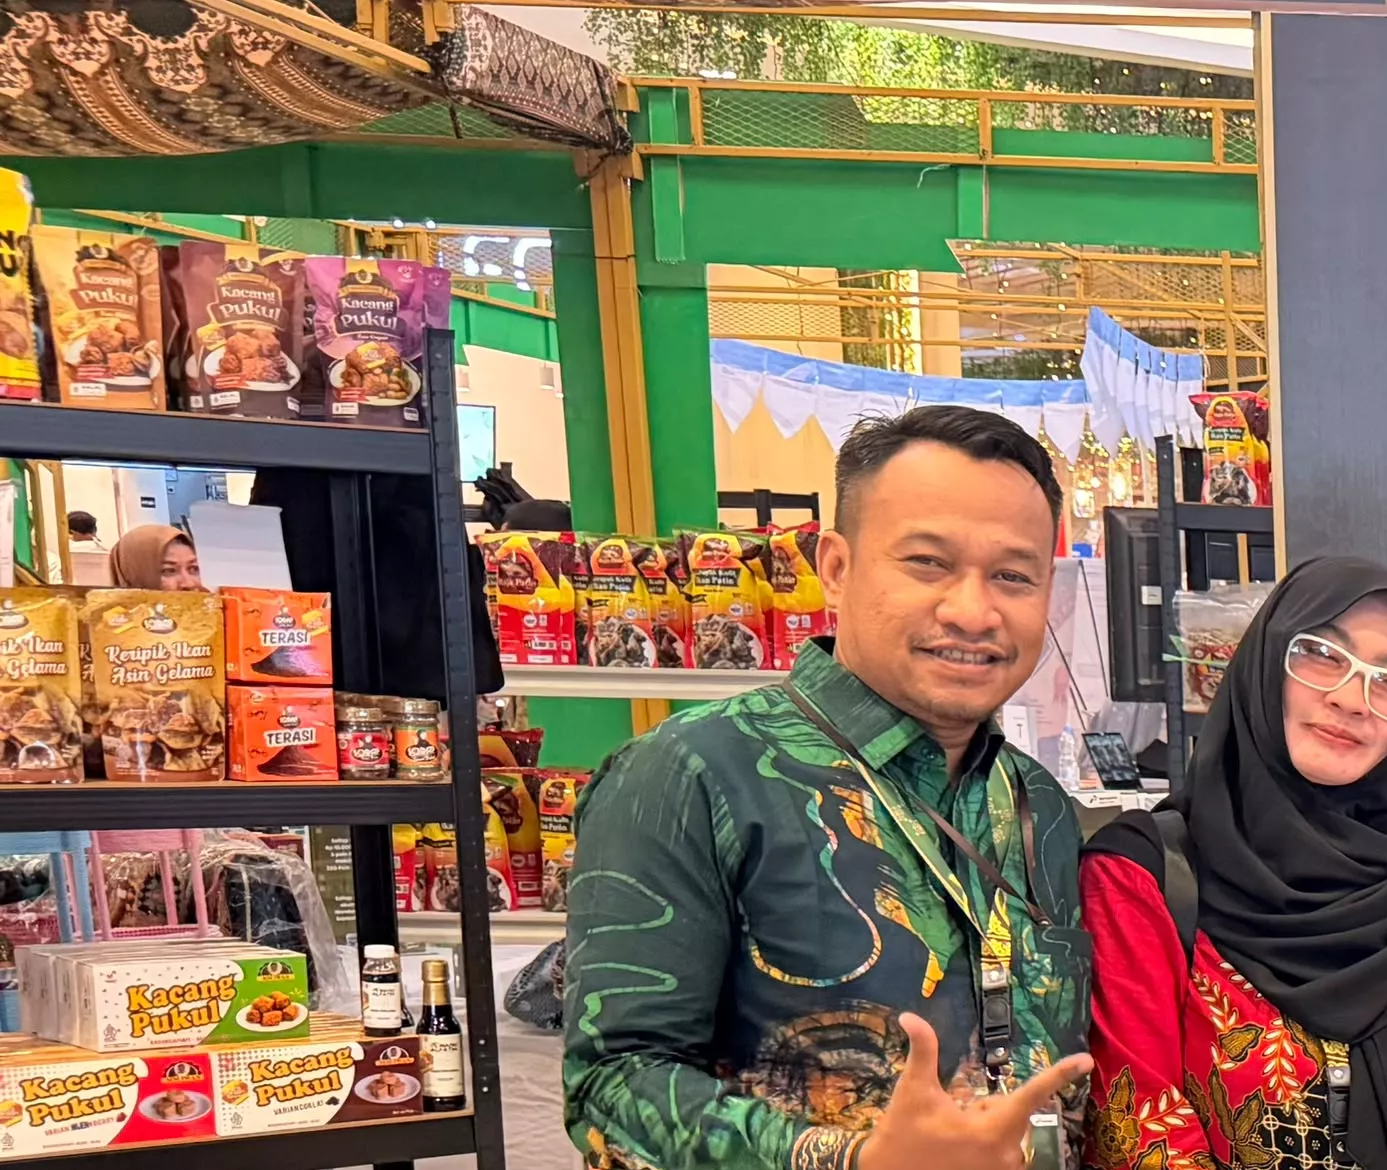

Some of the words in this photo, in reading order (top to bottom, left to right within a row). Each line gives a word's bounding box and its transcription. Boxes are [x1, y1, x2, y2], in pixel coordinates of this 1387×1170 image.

[221, 286, 276, 301] Kacang
[341, 298, 395, 312] Kacang
[261, 632, 309, 645] TERASI
[105, 643, 171, 666] Keripik
[171, 641, 212, 658] Ikan
[7, 659, 67, 679] Gelama
[111, 667, 151, 686] Asin
[155, 664, 215, 685] Gelama
[267, 730, 314, 745] TERASI
[126, 973, 238, 1013] Kacang
[129, 998, 224, 1038] Pukul
[249, 1046, 354, 1083] Kacang
[20, 1062, 139, 1102] Kacang
[254, 1070, 343, 1107] Pukul
[26, 1087, 126, 1127] Pukul
